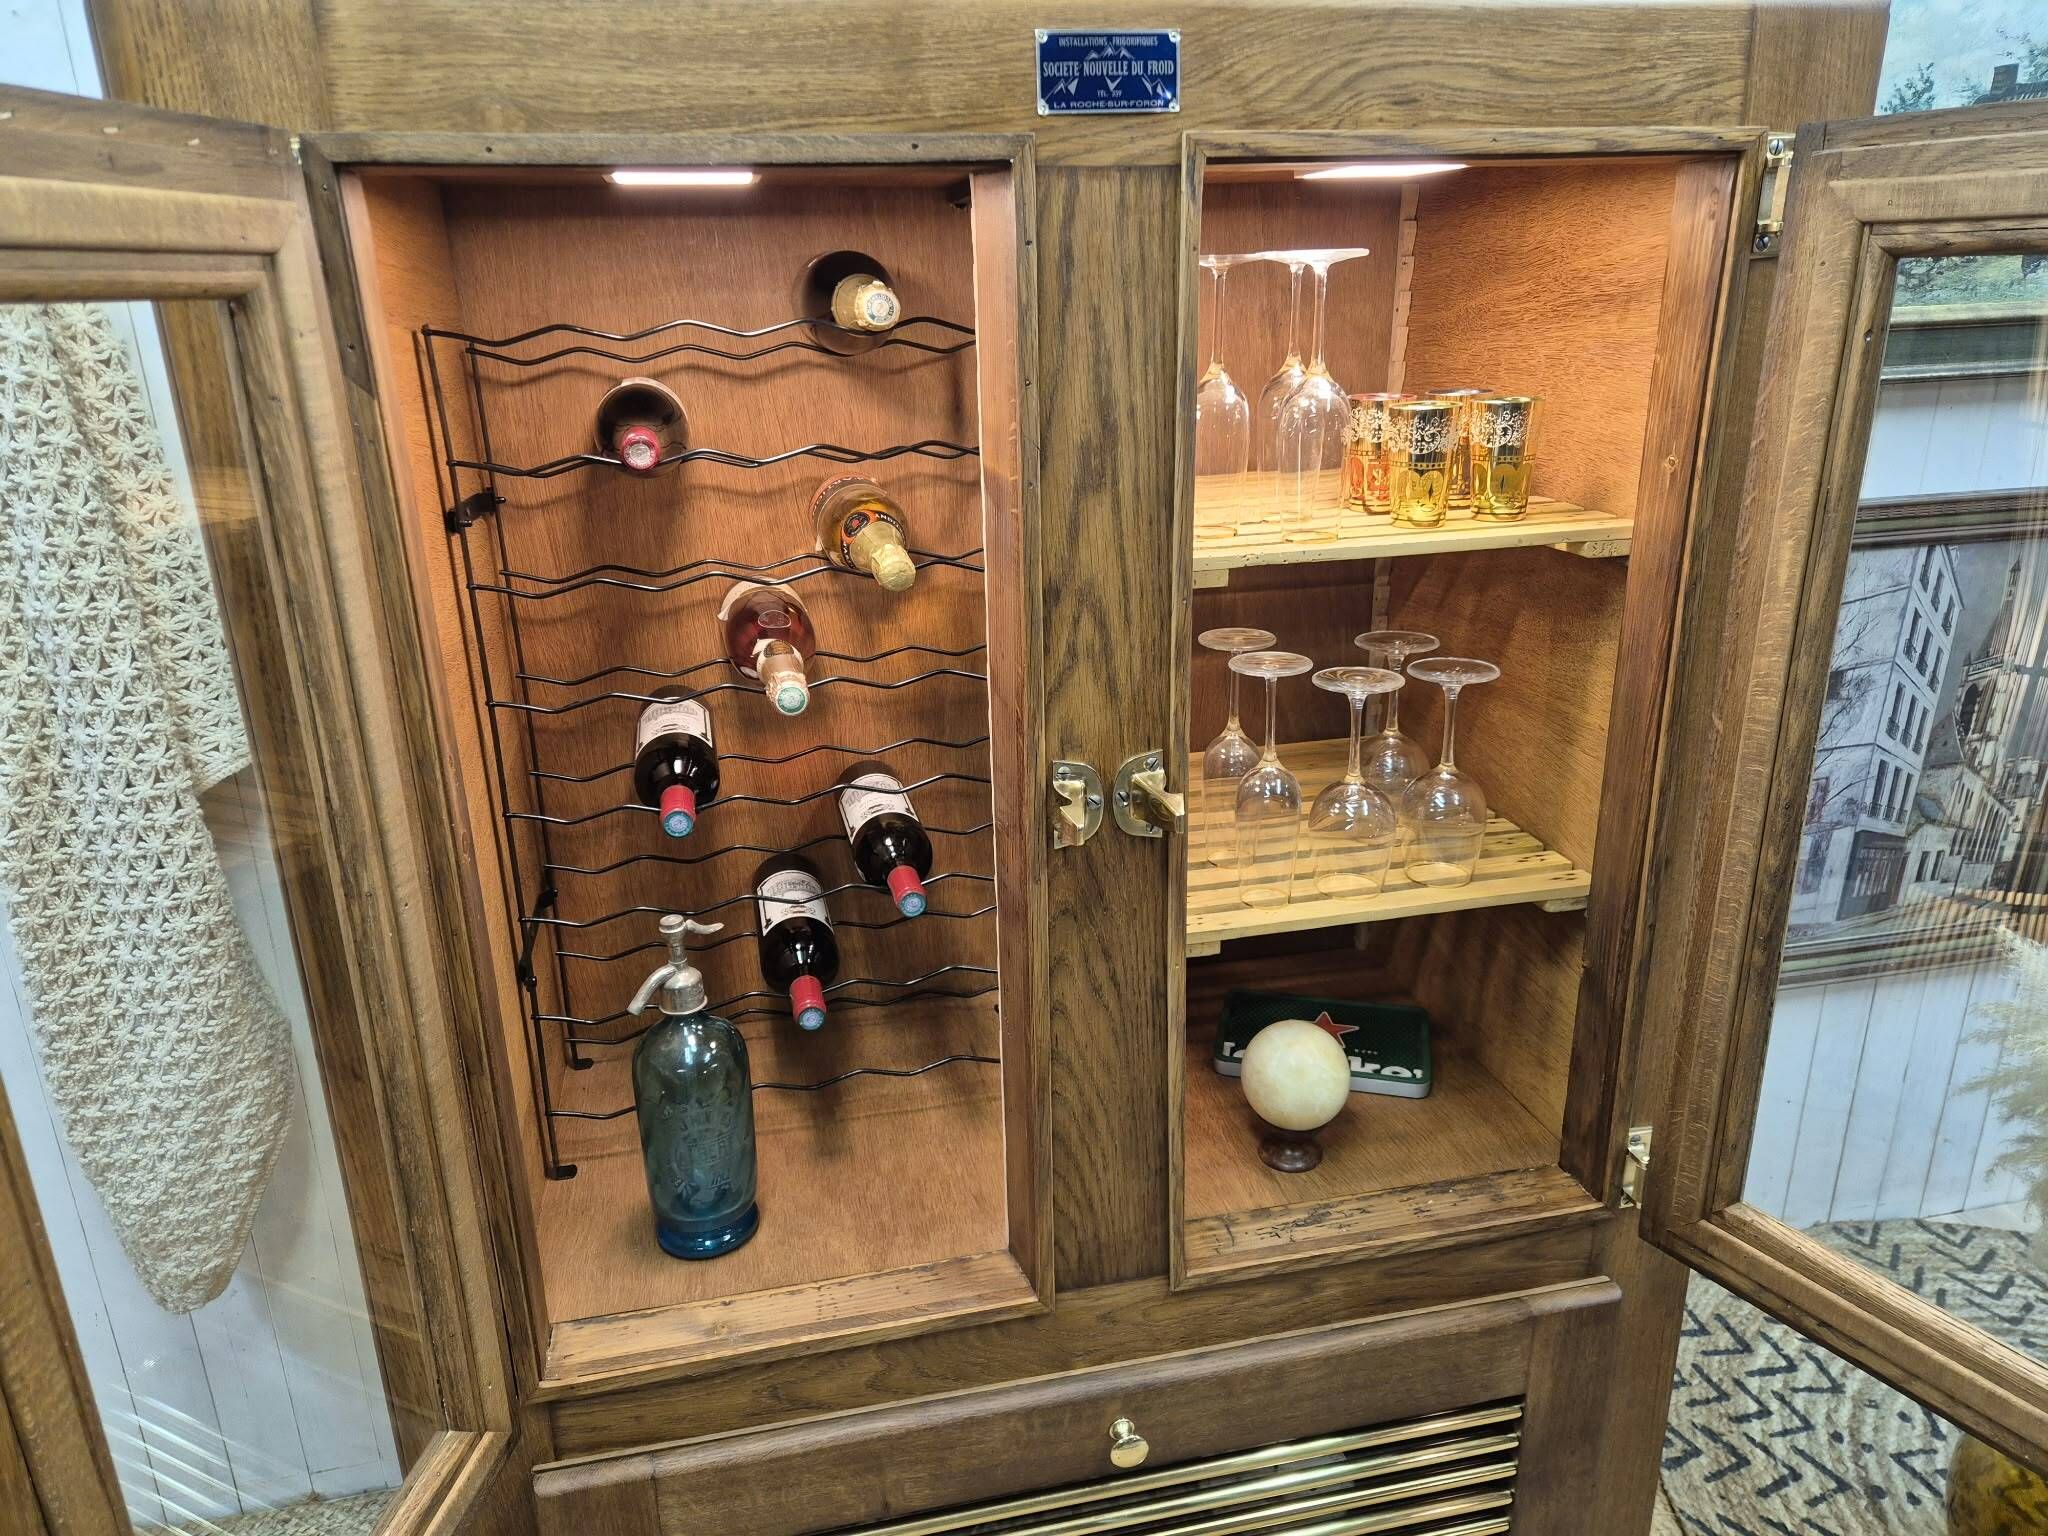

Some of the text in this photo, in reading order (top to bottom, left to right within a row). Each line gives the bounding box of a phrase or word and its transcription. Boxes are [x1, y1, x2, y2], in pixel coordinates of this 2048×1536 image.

[1058, 36, 1107, 46] INSTALLATIONS
[1083, 61, 1128, 76] NOUVELLE
[1132, 60, 1144, 76] DU
[1148, 60, 1174, 75] FROID
